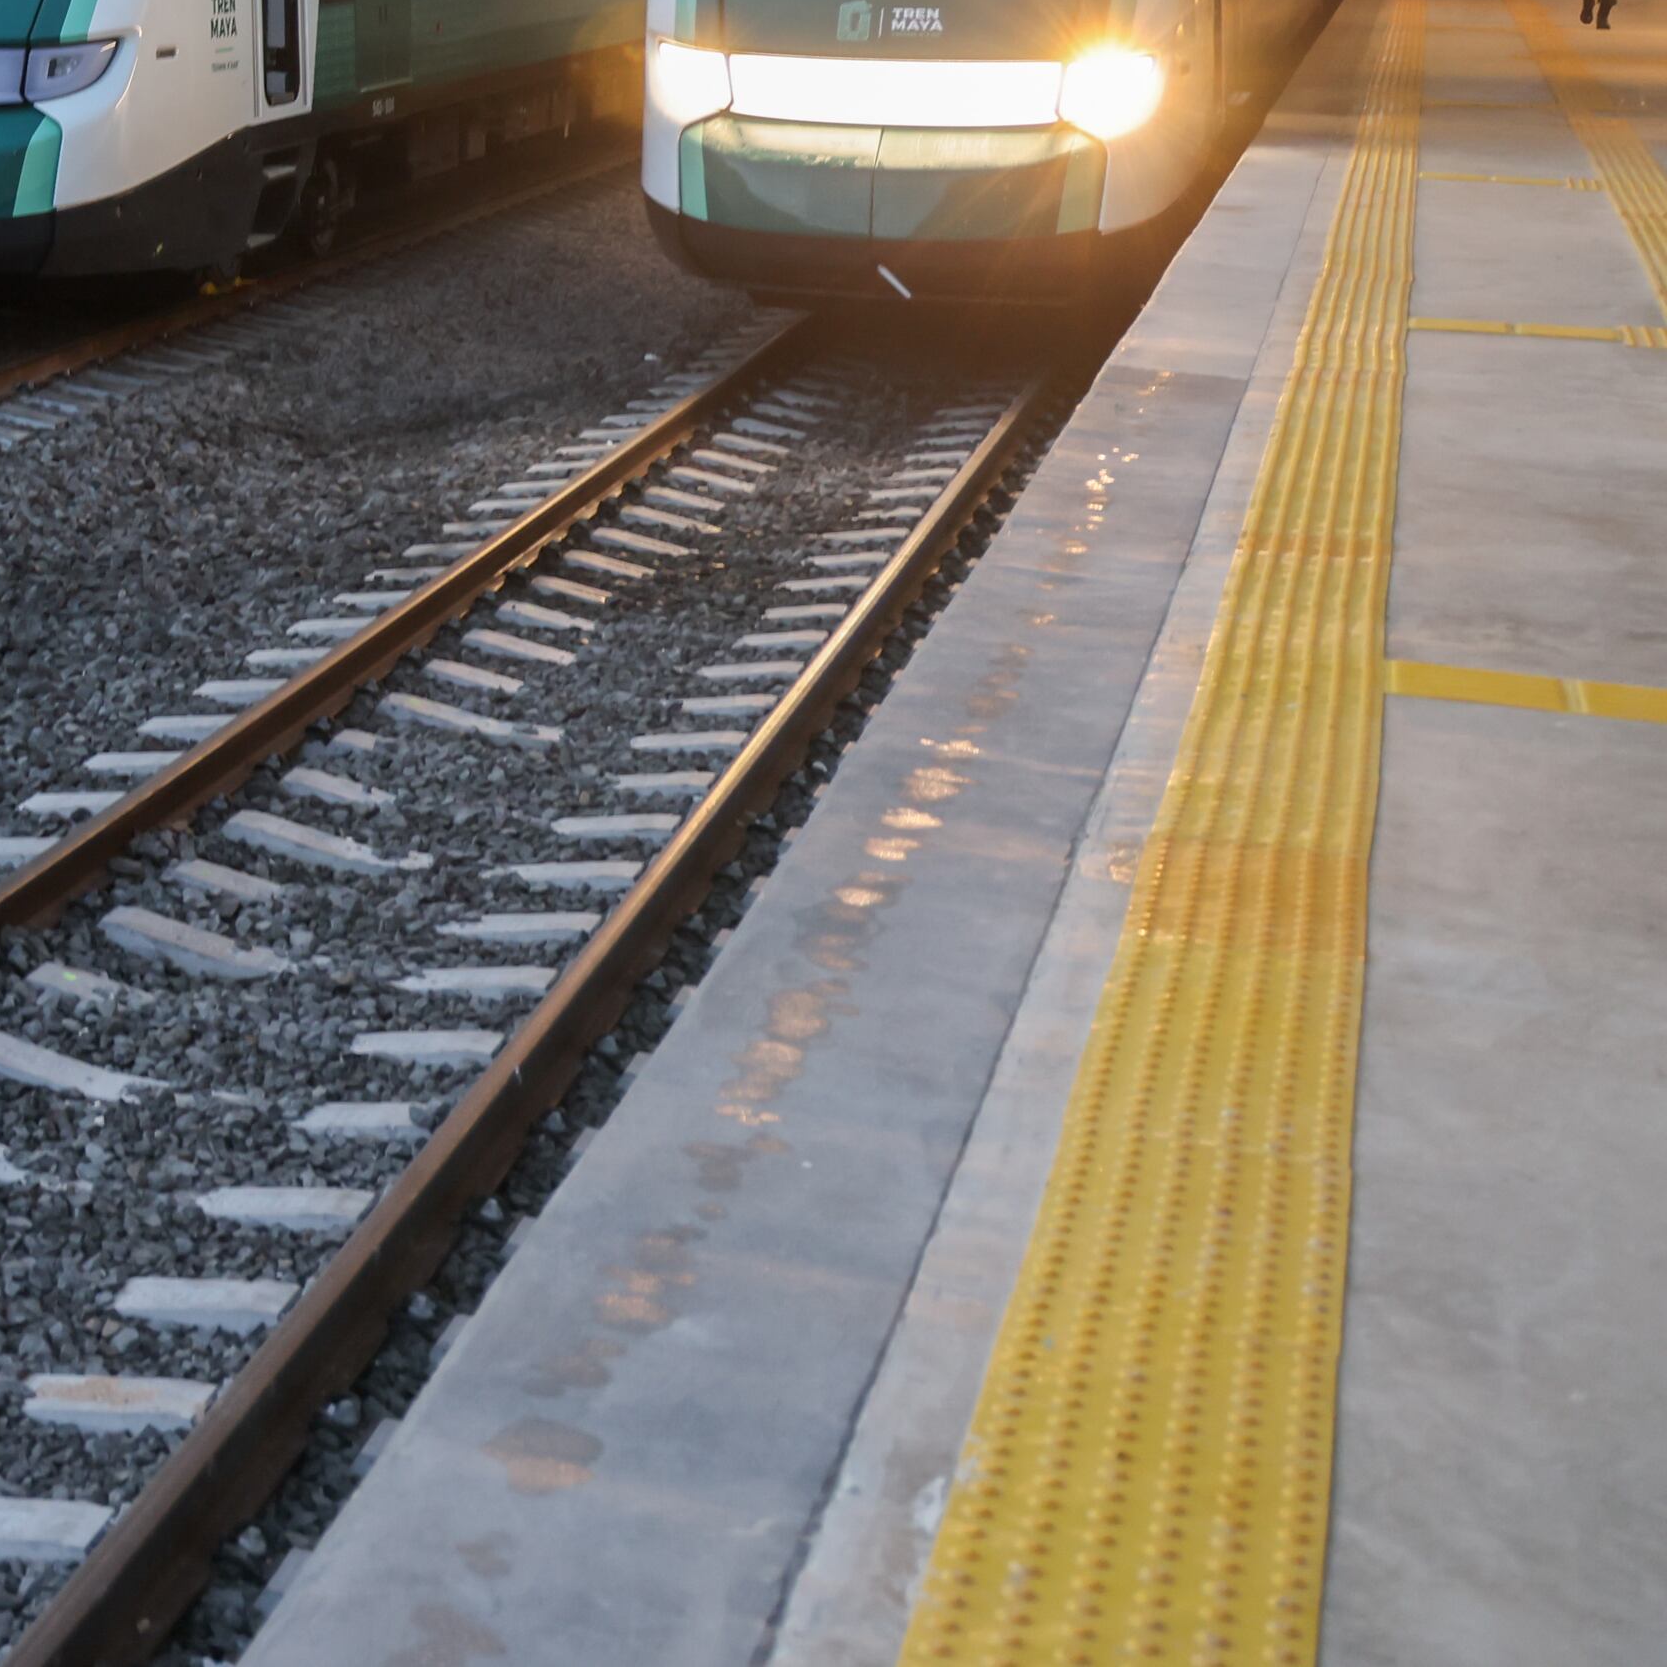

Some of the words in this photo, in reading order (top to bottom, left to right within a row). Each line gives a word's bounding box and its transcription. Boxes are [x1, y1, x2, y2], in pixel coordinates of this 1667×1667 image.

[891, 7, 940, 19] TREN
[210, 16, 238, 38] MAYA
[891, 18, 943, 32] MAYA
